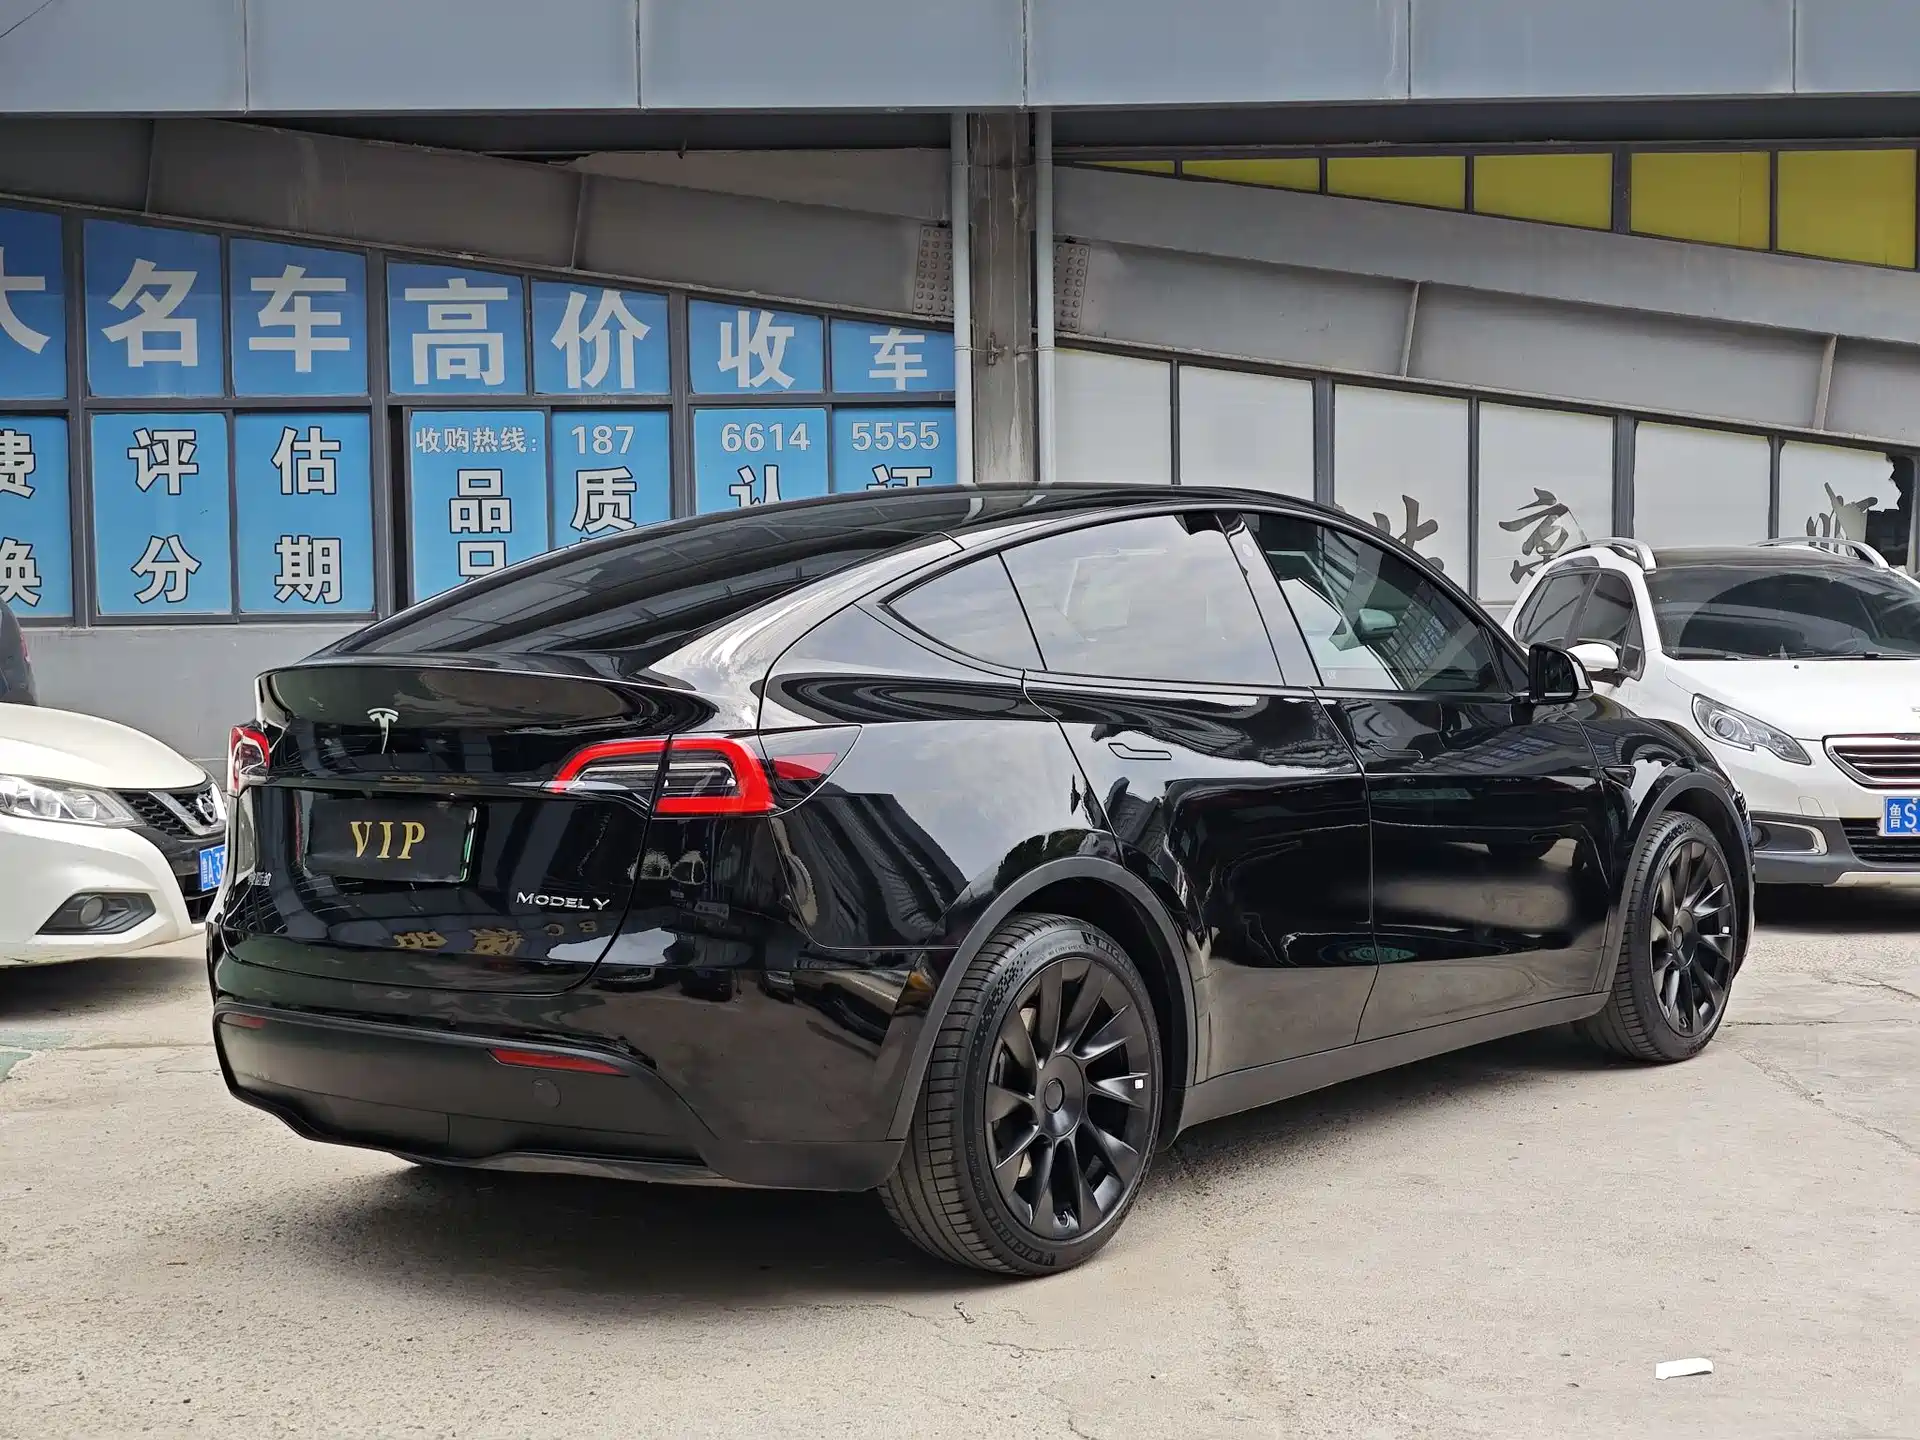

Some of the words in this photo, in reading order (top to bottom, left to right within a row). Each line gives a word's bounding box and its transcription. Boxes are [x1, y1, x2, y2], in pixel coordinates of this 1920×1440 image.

[416, 425, 538, 454] 收购热线：
[571, 425, 636, 455] 187
[721, 422, 811, 453] 6614
[852, 420, 941, 452] 5555
[350, 821, 425, 859] VIP
[516, 891, 591, 910] MODEL
